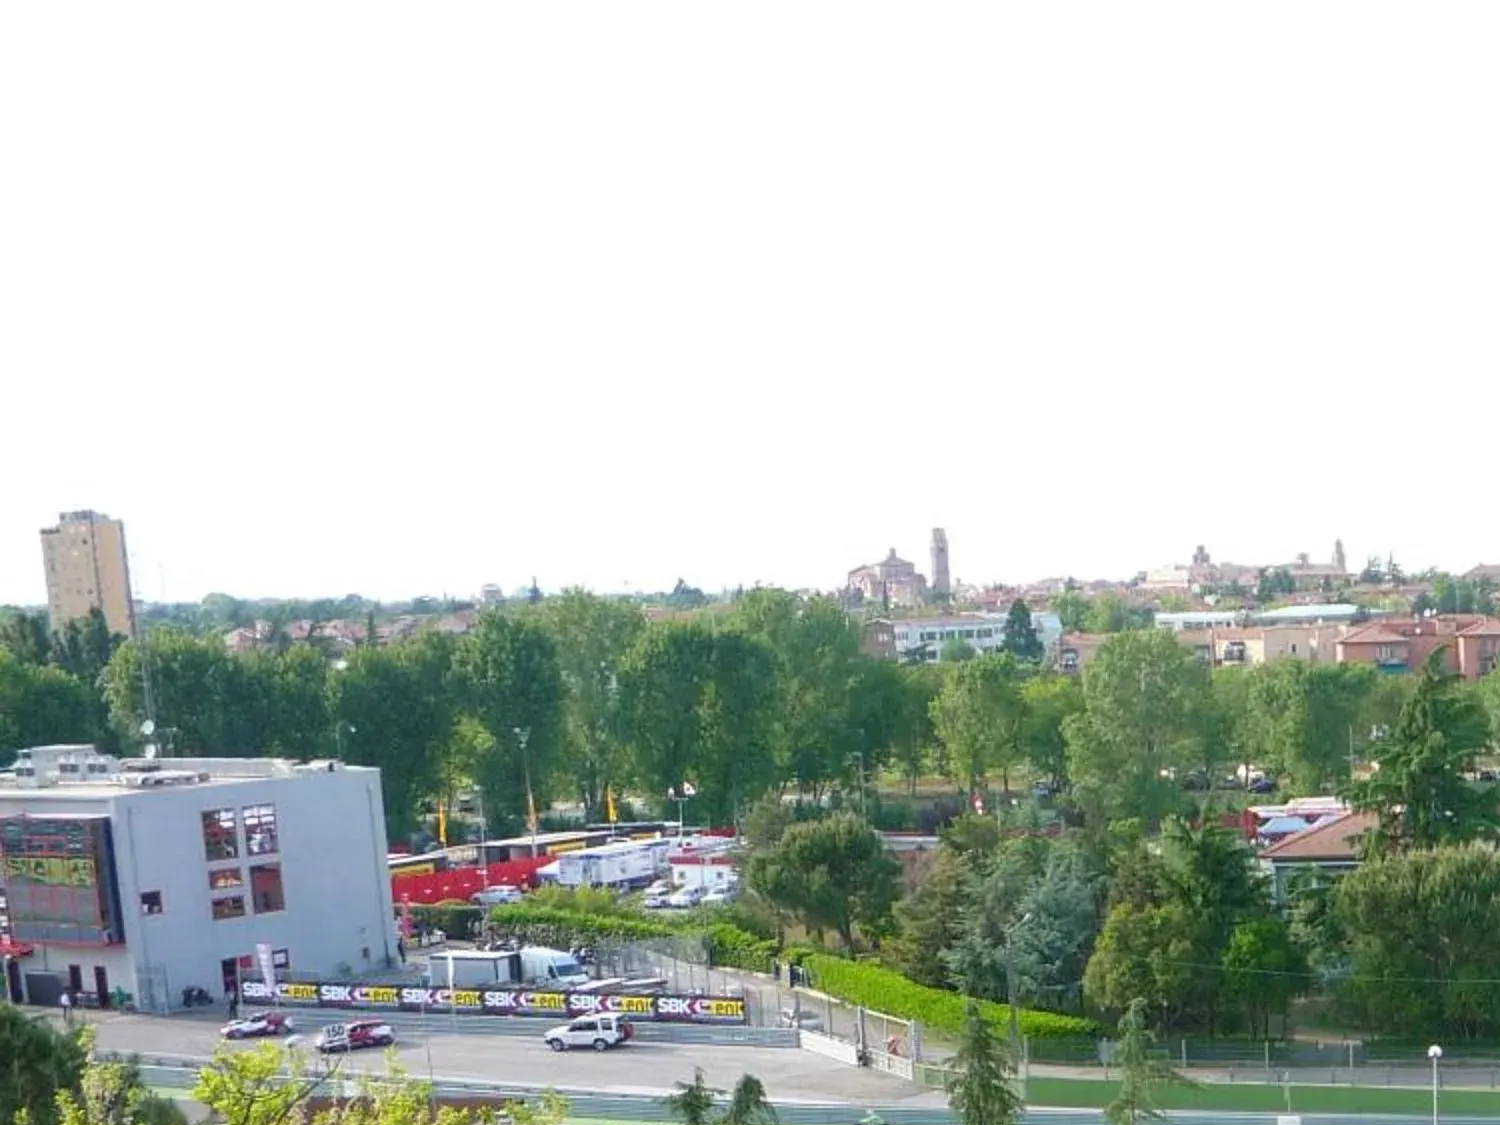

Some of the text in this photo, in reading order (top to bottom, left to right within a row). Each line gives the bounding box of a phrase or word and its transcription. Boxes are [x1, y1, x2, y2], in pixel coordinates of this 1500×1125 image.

[320, 985, 351, 1000] SBK
[402, 988, 433, 1003] SBK
[484, 992, 516, 1007] SBK
[570, 995, 602, 1010] SBK
[658, 998, 742, 1015] SBK eni
[326, 1024, 345, 1038] 150
